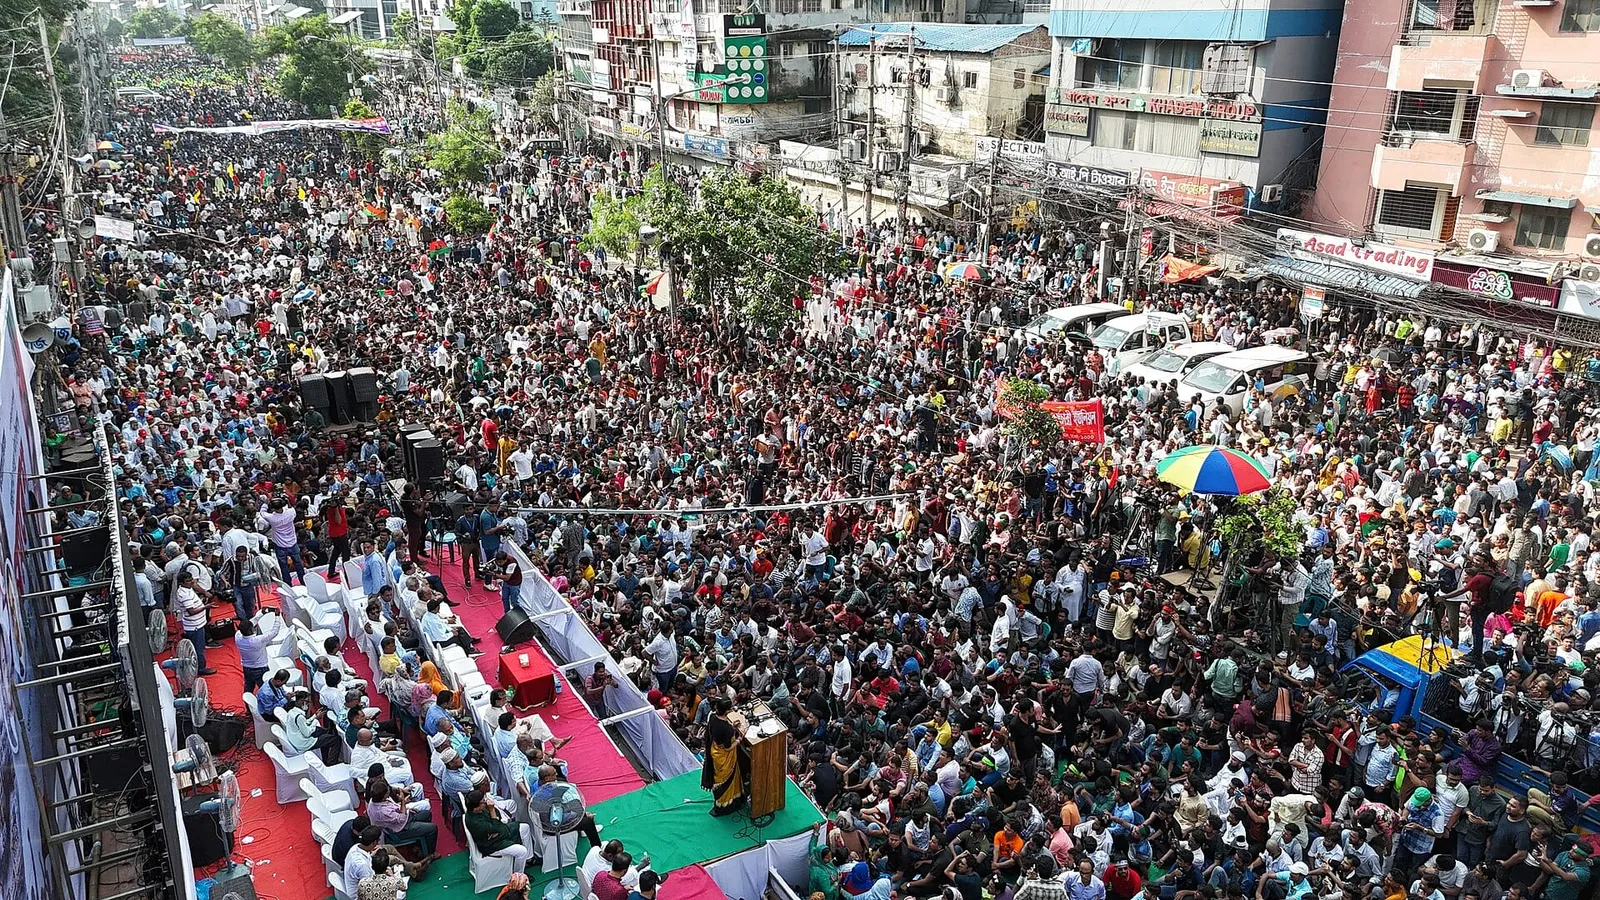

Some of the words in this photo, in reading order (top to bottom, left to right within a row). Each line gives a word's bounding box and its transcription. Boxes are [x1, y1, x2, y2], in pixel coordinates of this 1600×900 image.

[1148, 97, 1203, 116] KHADEM
[1207, 101, 1256, 121] GROUP
[1304, 237, 1347, 257] Asad
[1350, 243, 1430, 273] Trading
